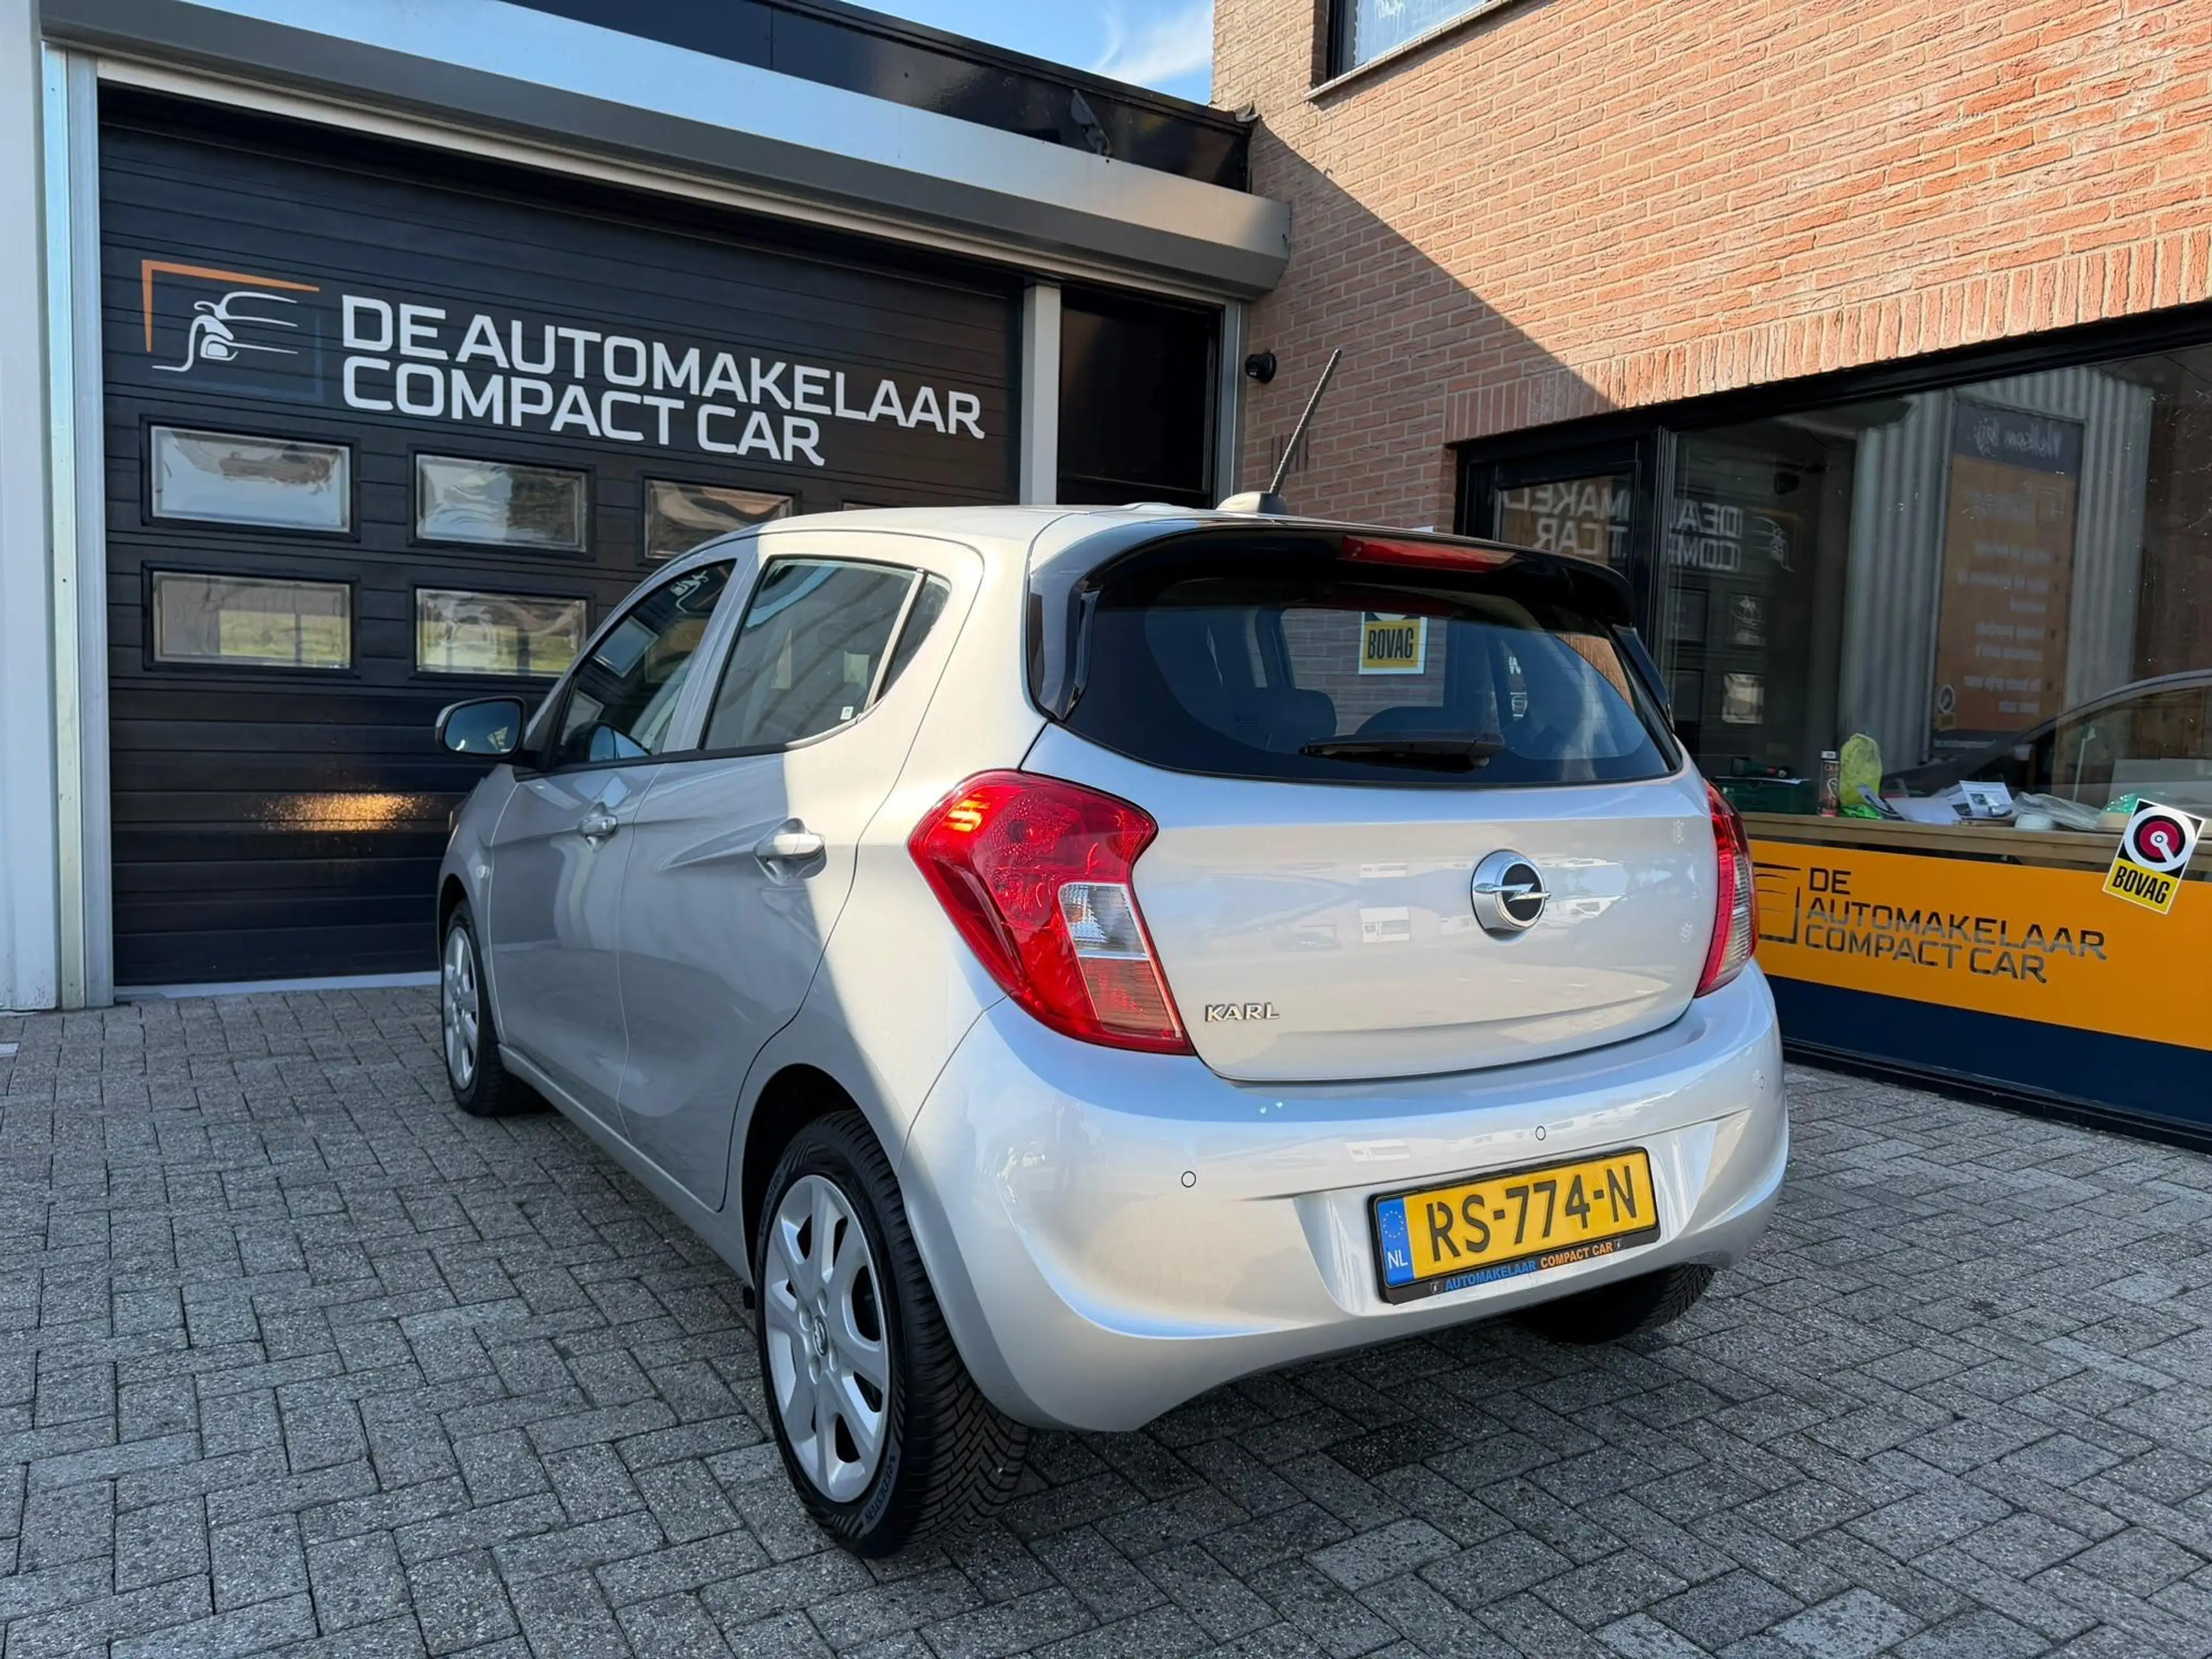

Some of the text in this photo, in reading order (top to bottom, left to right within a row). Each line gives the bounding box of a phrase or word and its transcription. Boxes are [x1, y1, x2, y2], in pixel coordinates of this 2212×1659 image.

[342, 294, 986, 440] DE AUTOMAKELAAR
[343, 356, 825, 466] COMPACT CAR
[1367, 627, 1415, 660] BOVAG
[1809, 867, 1851, 896] DE
[2112, 866, 2171, 904] BOVAG
[1806, 924, 2047, 984] COMPACT CAR
[1808, 896, 2107, 961] AUTOMAKELAAR
[1205, 1002, 1280, 1022] KARL
[1426, 1165, 1637, 1262] RS-774-N
[1388, 1250, 1408, 1269] NL
[1445, 1241, 1613, 1293] AUTOMAKELAAR COMPACT CAR
